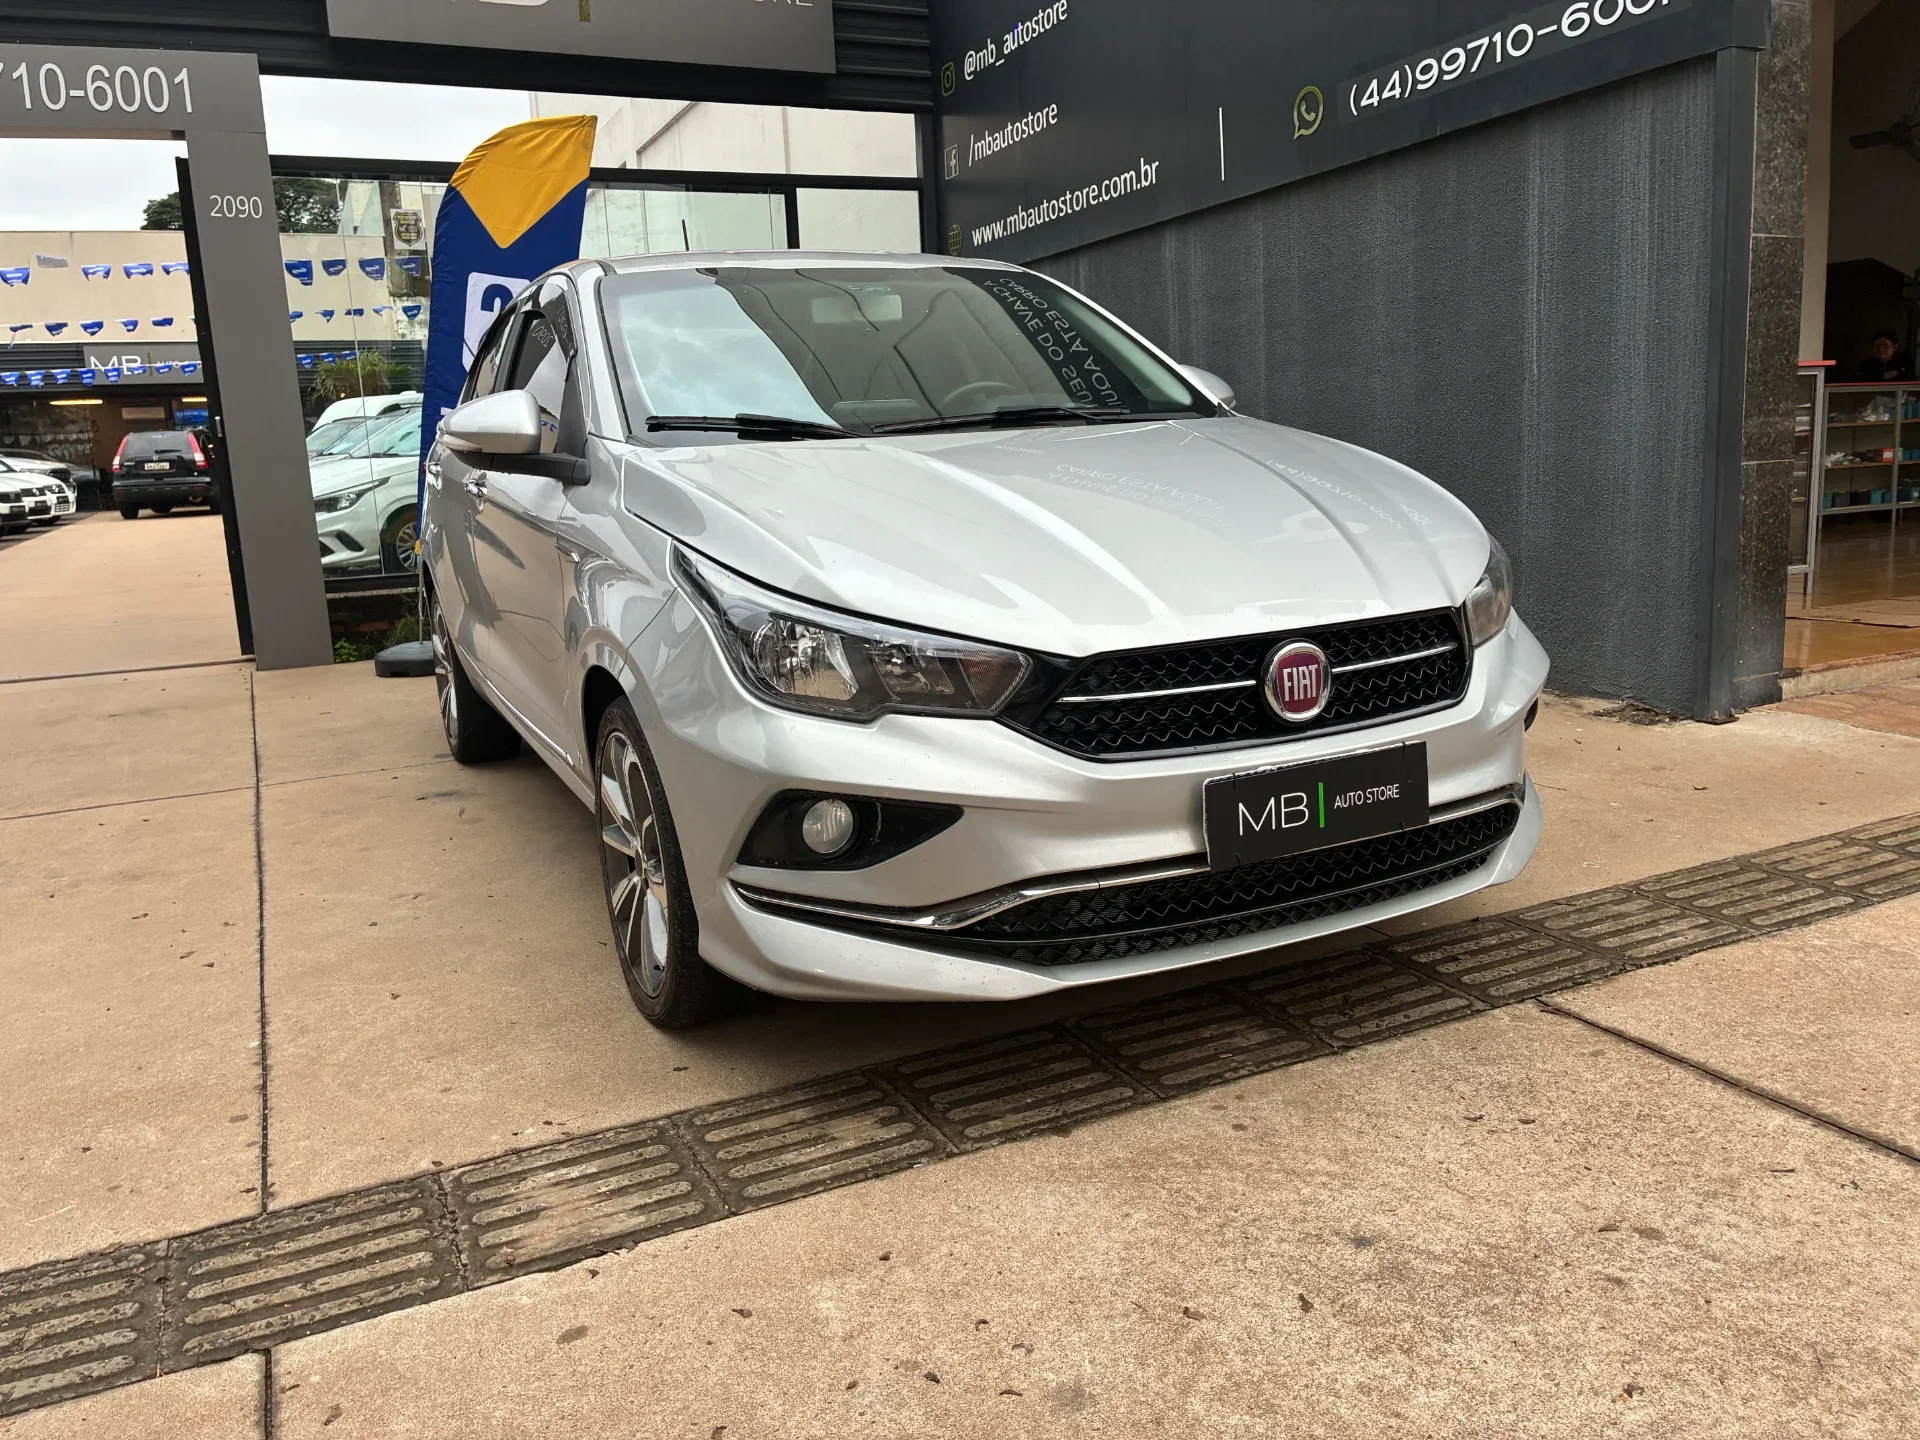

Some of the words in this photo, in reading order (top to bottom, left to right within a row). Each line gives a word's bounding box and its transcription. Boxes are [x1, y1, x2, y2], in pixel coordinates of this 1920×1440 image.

[964, 0, 1068, 80] @mb_autostore
[1349, 0, 1670, 116] (44)99710-60
[0, 62, 193, 113] 10-6001
[968, 103, 1058, 166] /mbautostore
[209, 195, 263, 219] 2090
[971, 157, 1159, 247] www.mbautostore.com.br
[1282, 664, 1318, 702] FIAT
[1238, 792, 1309, 836] MB
[1334, 790, 1364, 809] AUTO
[1366, 784, 1400, 803] STORE
